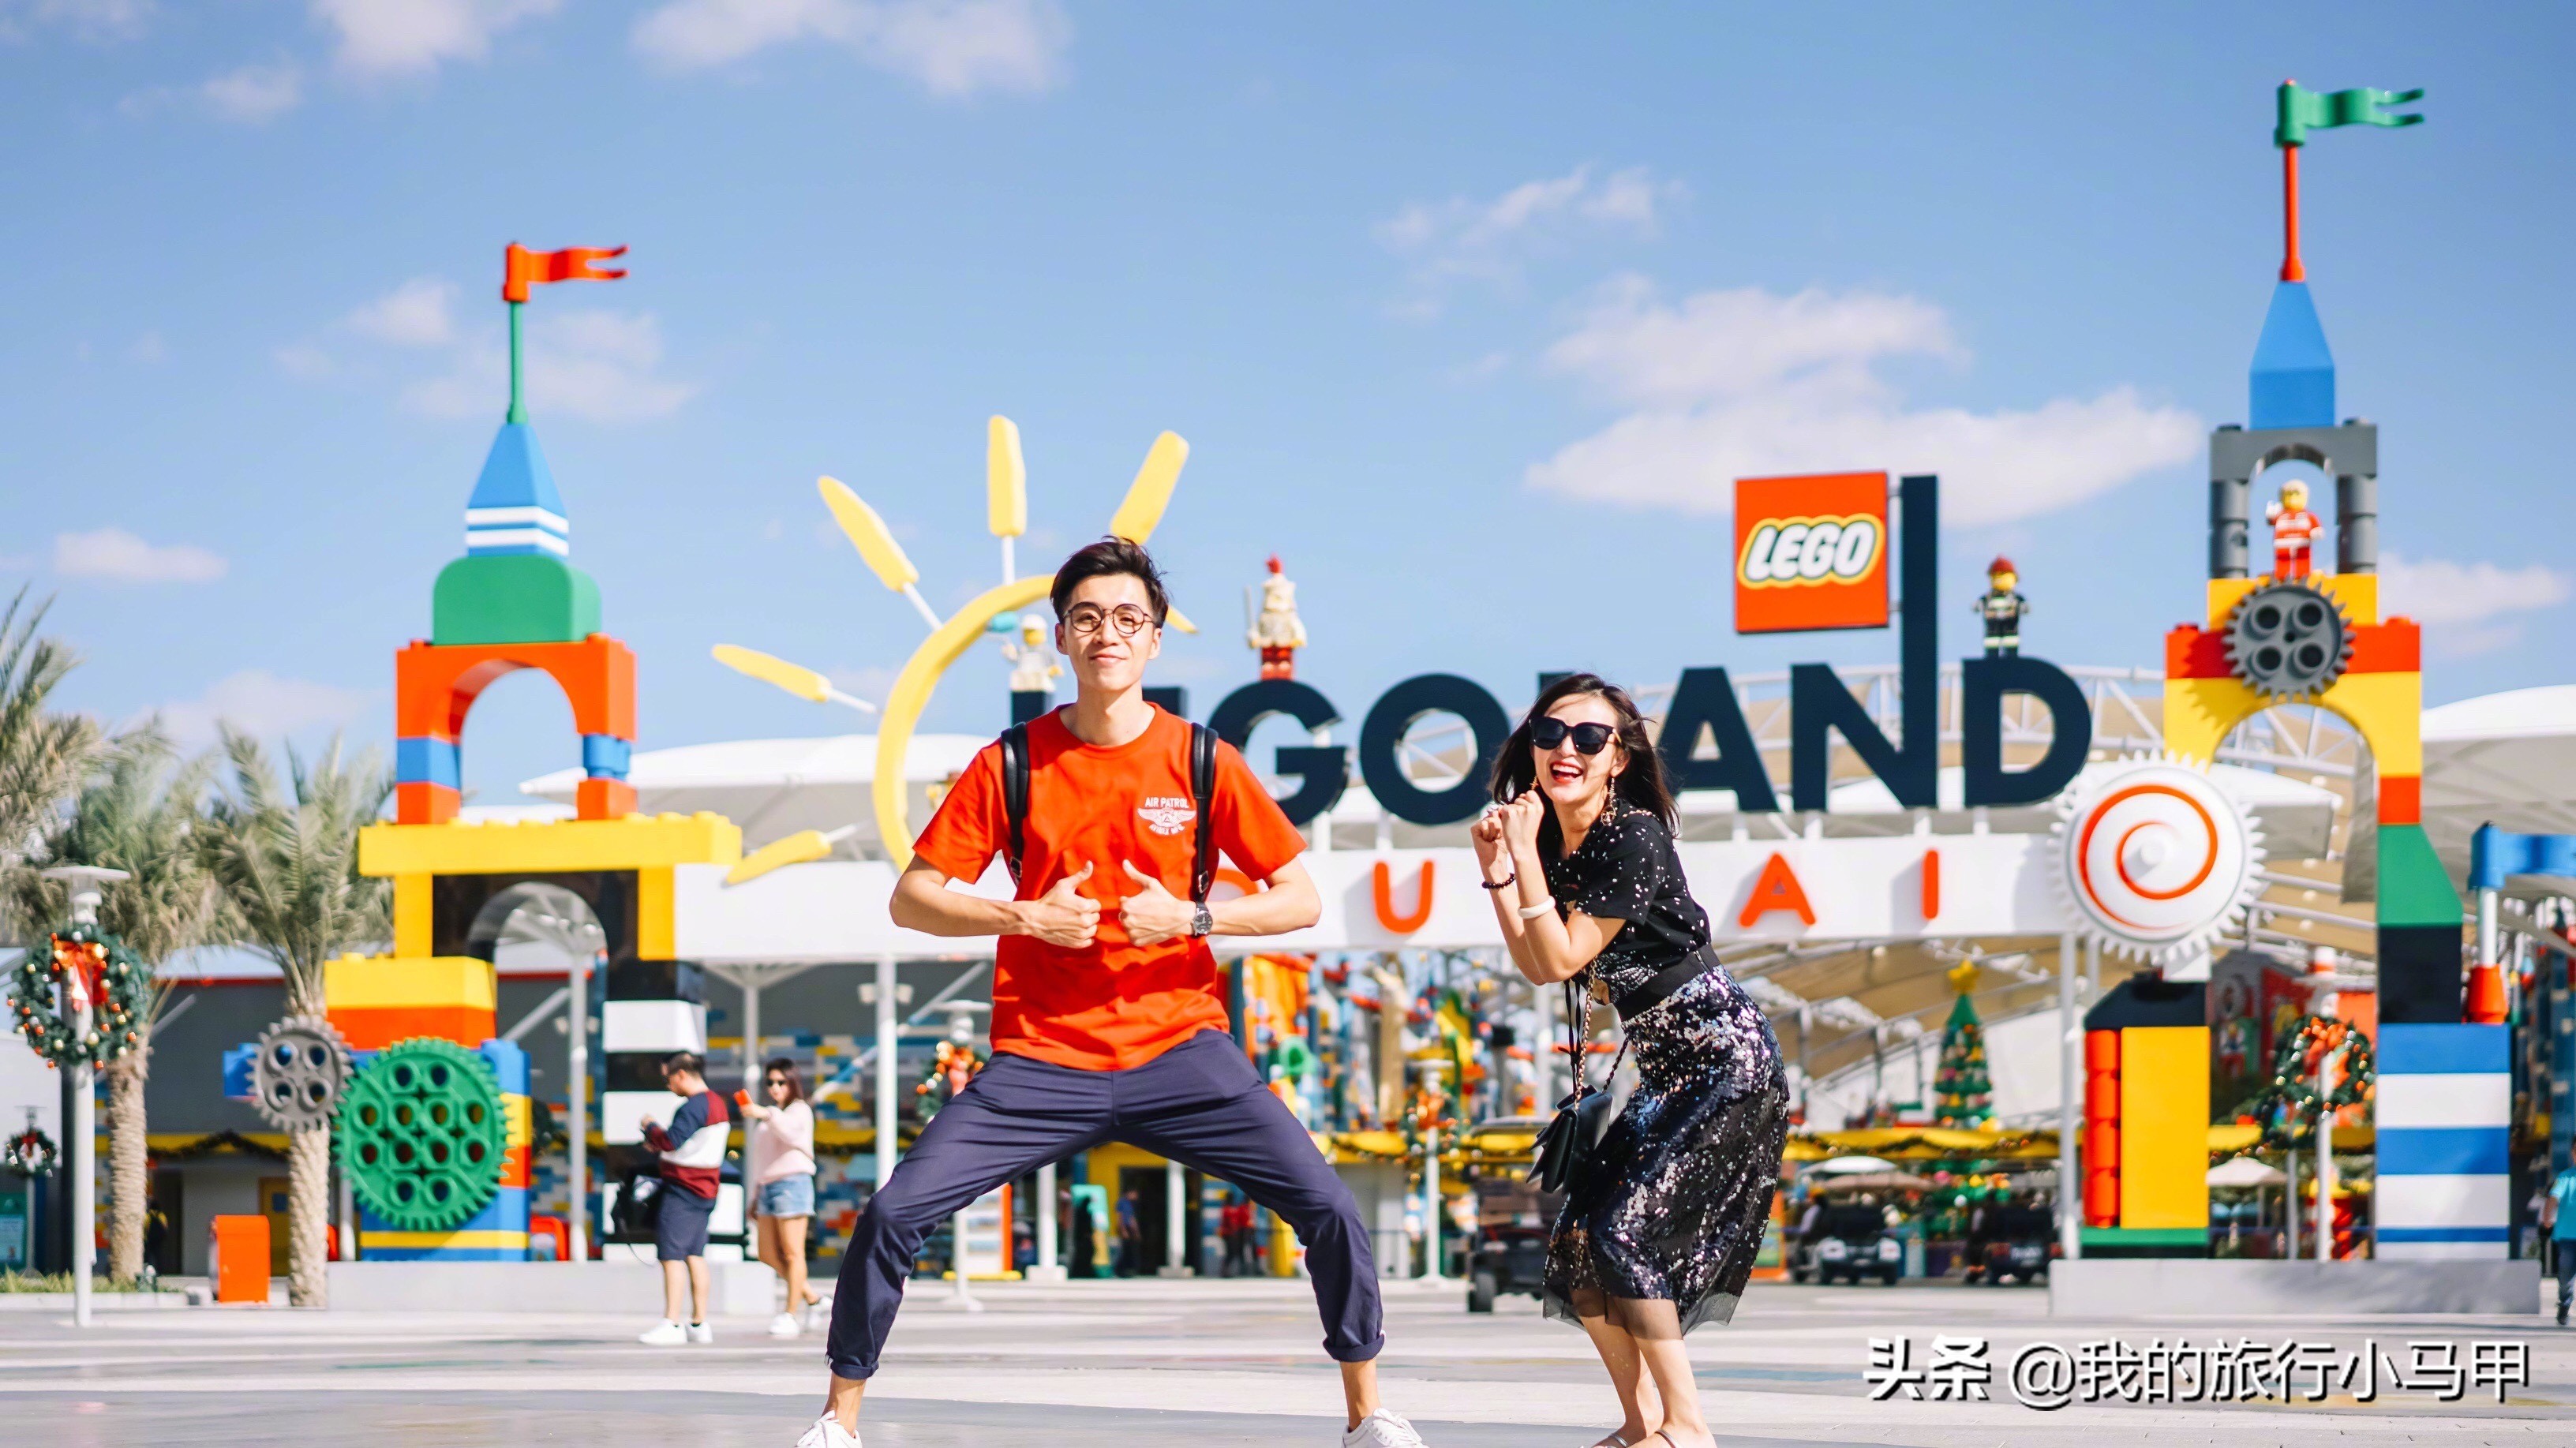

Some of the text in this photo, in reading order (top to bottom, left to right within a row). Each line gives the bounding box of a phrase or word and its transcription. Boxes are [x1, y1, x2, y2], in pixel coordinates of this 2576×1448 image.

[1741, 518, 1879, 585] LEGO
[1144, 796, 1189, 809] AIR PATROL
[1208, 849, 1940, 934] UAI
